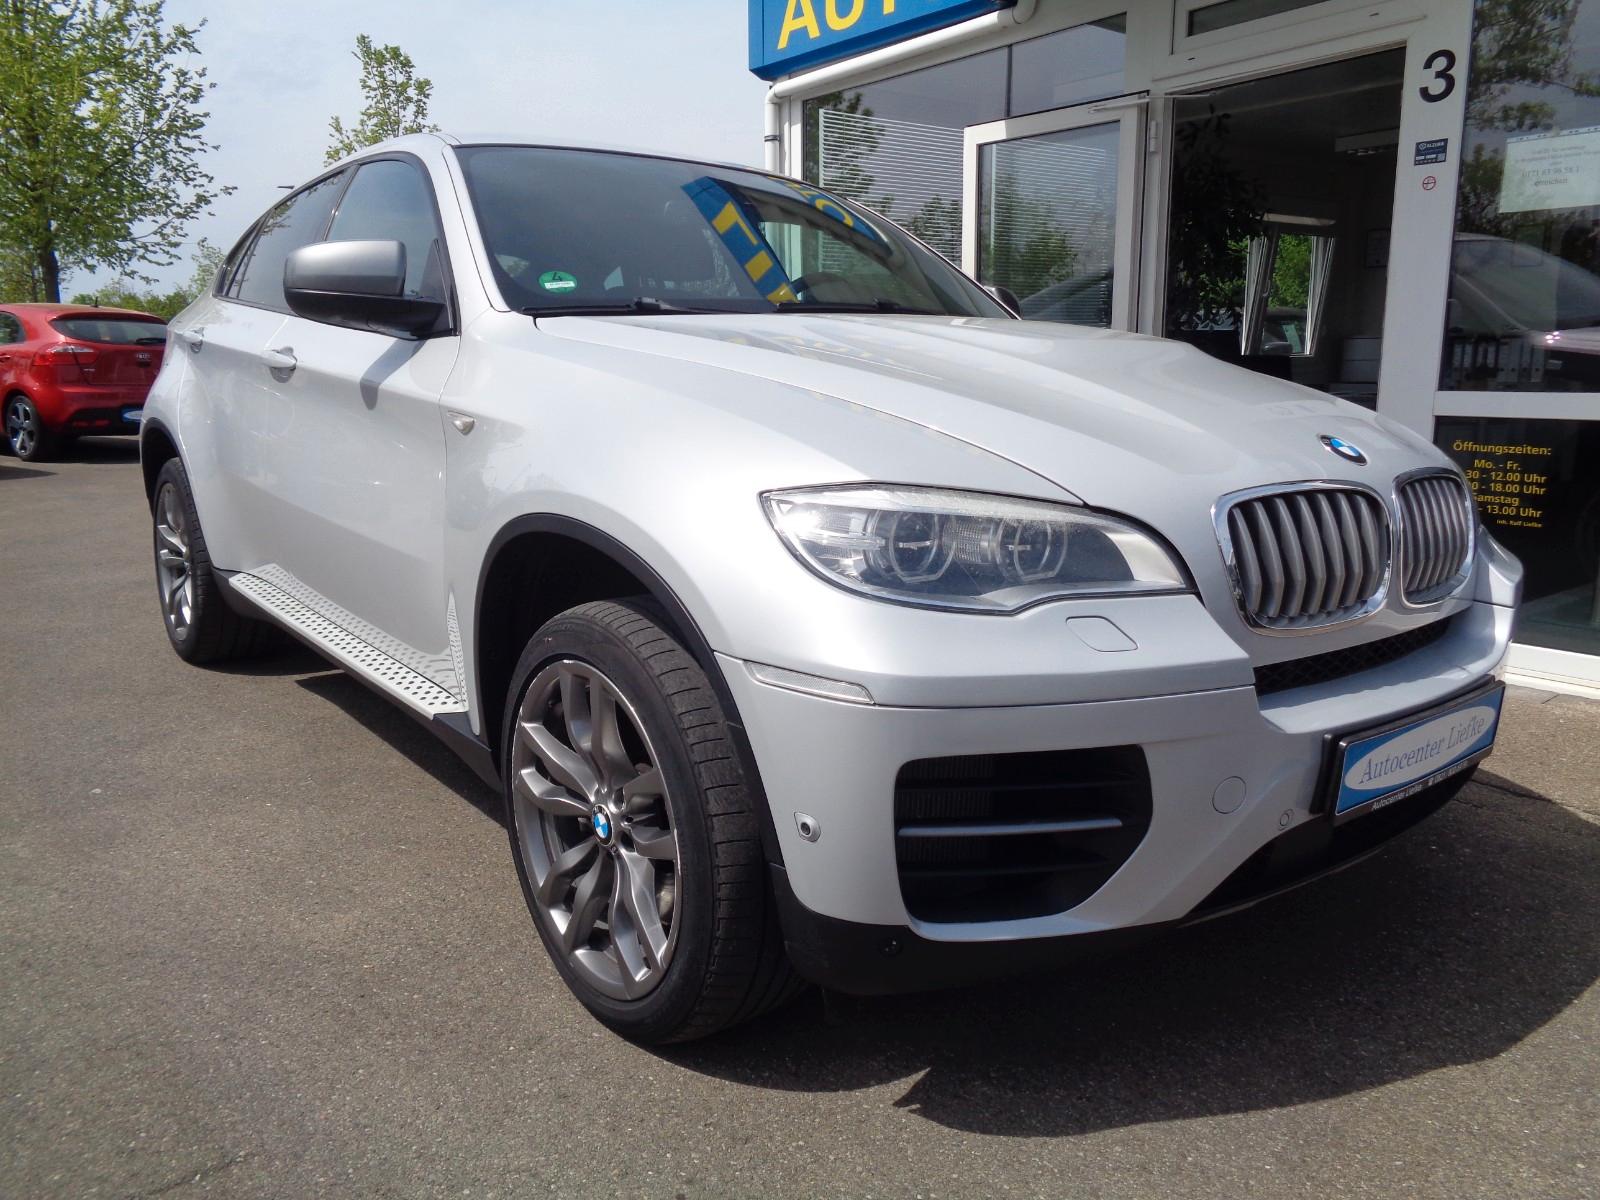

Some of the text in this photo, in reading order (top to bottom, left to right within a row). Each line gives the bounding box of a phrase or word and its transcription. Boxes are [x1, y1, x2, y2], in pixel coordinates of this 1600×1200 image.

[777, 0, 895, 50] AU
[1418, 49, 1457, 103] 3
[1453, 439, 1552, 456] Öffnungszeiten:
[1474, 459, 1496, 469] Mo.
[1506, 461, 1521, 471] Fr.
[1490, 472, 1520, 481] 12.00
[1524, 474, 1547, 483] Uhr
[1490, 483, 1520, 493] 18.00
[1523, 485, 1546, 495] Uhr
[1487, 505, 1516, 515] 13.00
[1520, 508, 1542, 518] Uhr
[1358, 737, 1446, 785] Autocenter
[1446, 714, 1486, 749] Liefke
